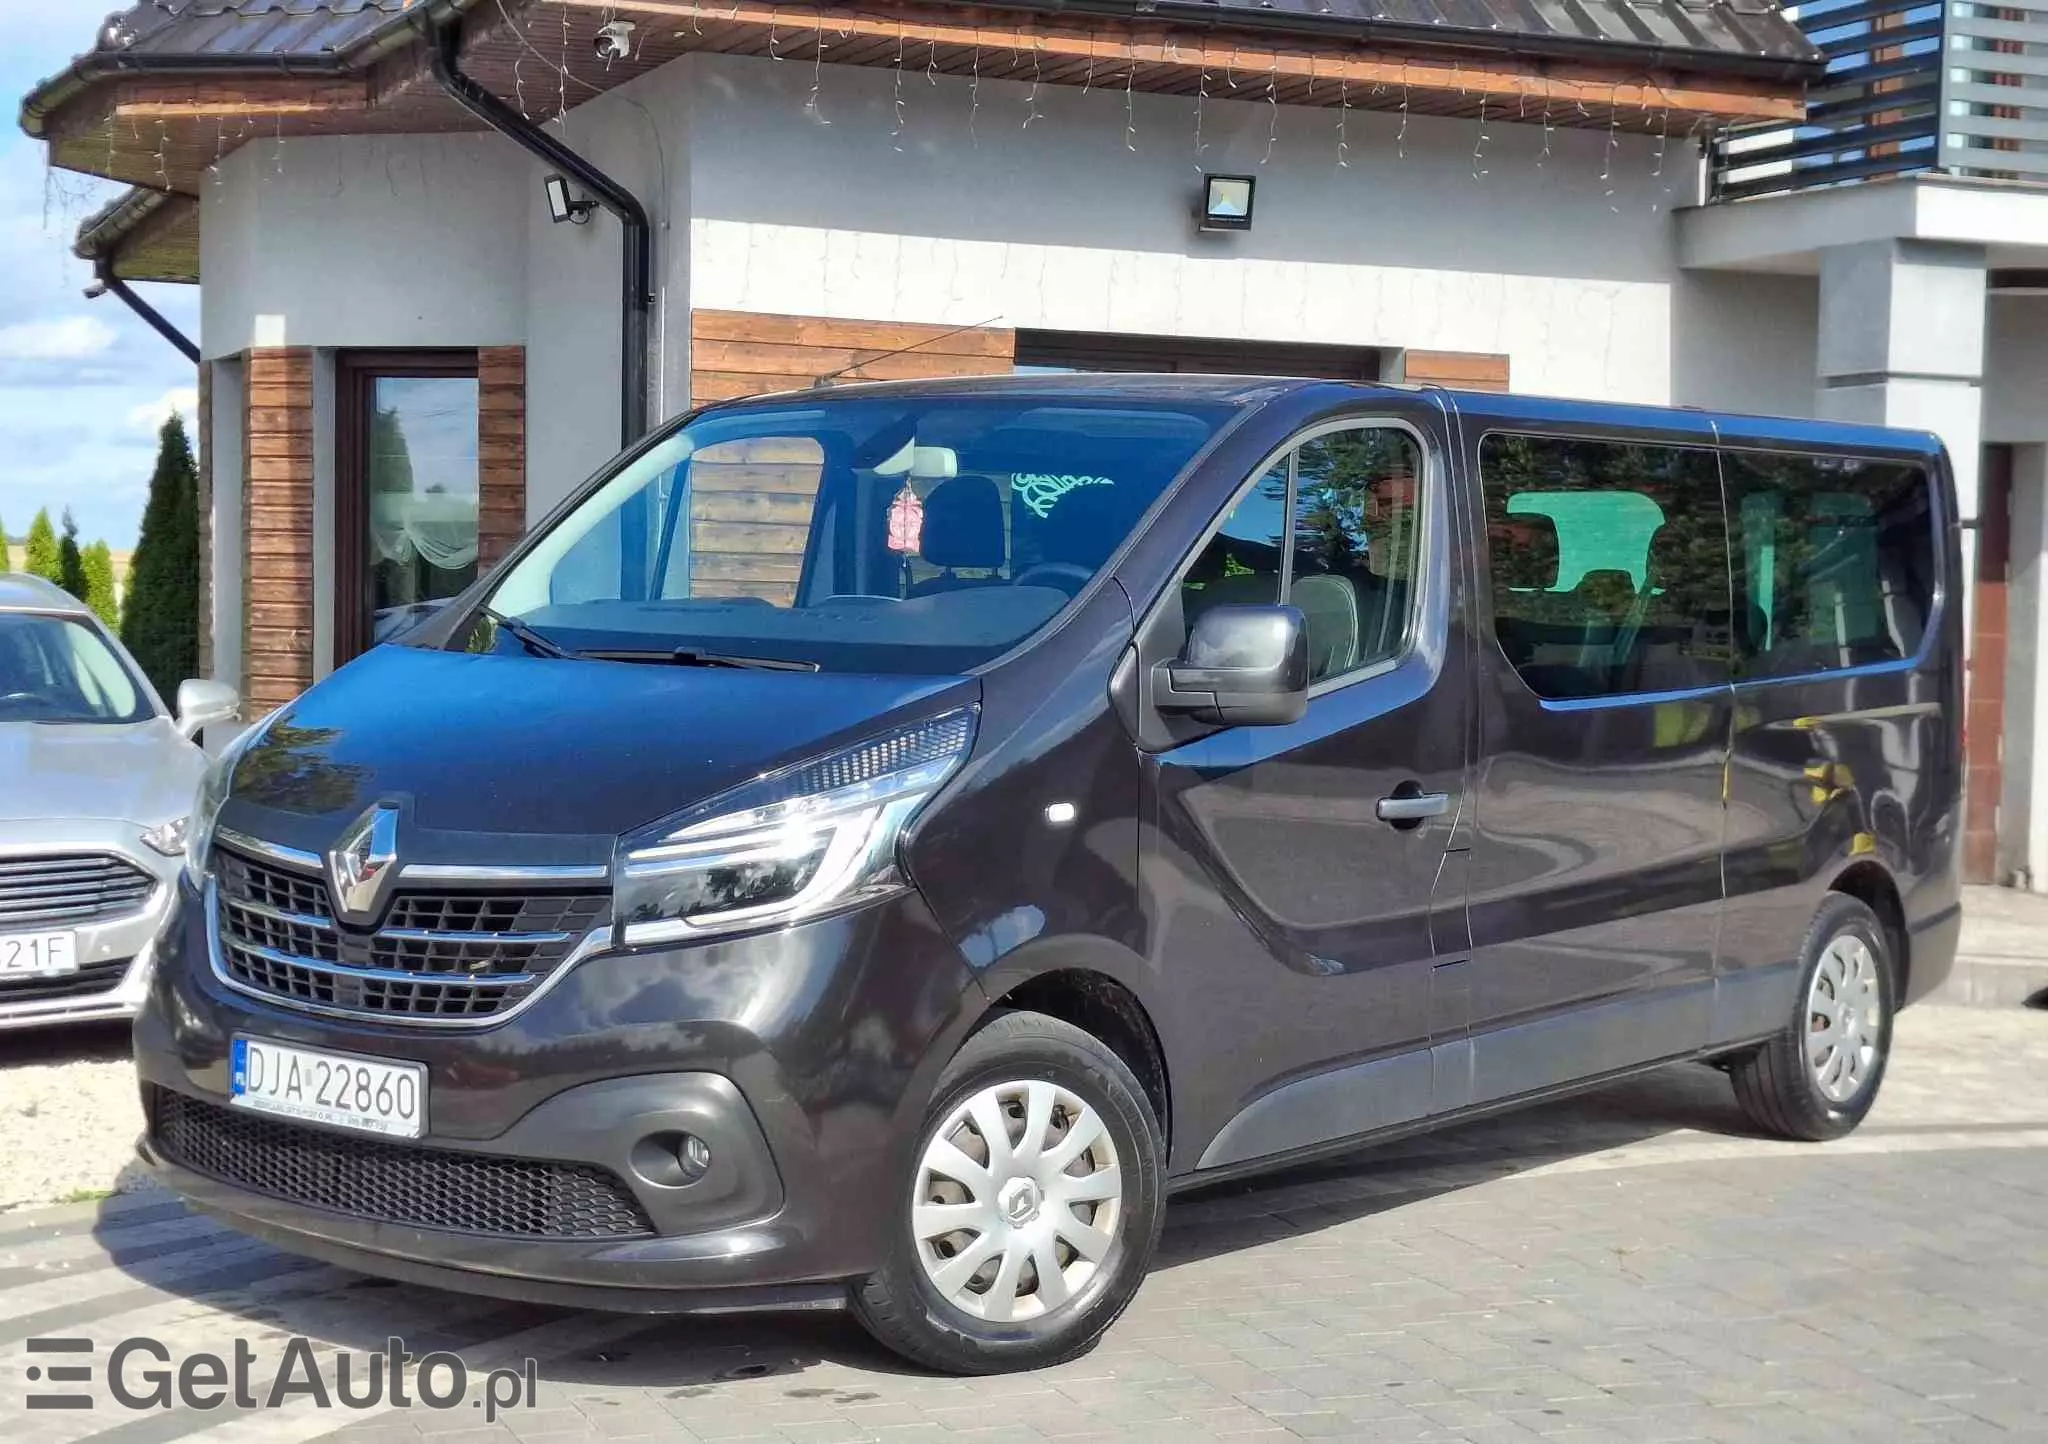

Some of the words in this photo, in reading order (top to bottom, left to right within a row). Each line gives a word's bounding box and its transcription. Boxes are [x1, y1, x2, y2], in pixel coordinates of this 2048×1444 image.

[0, 937, 65, 968] 21F
[249, 1048, 303, 1101] DJA
[316, 1061, 415, 1119] 22860
